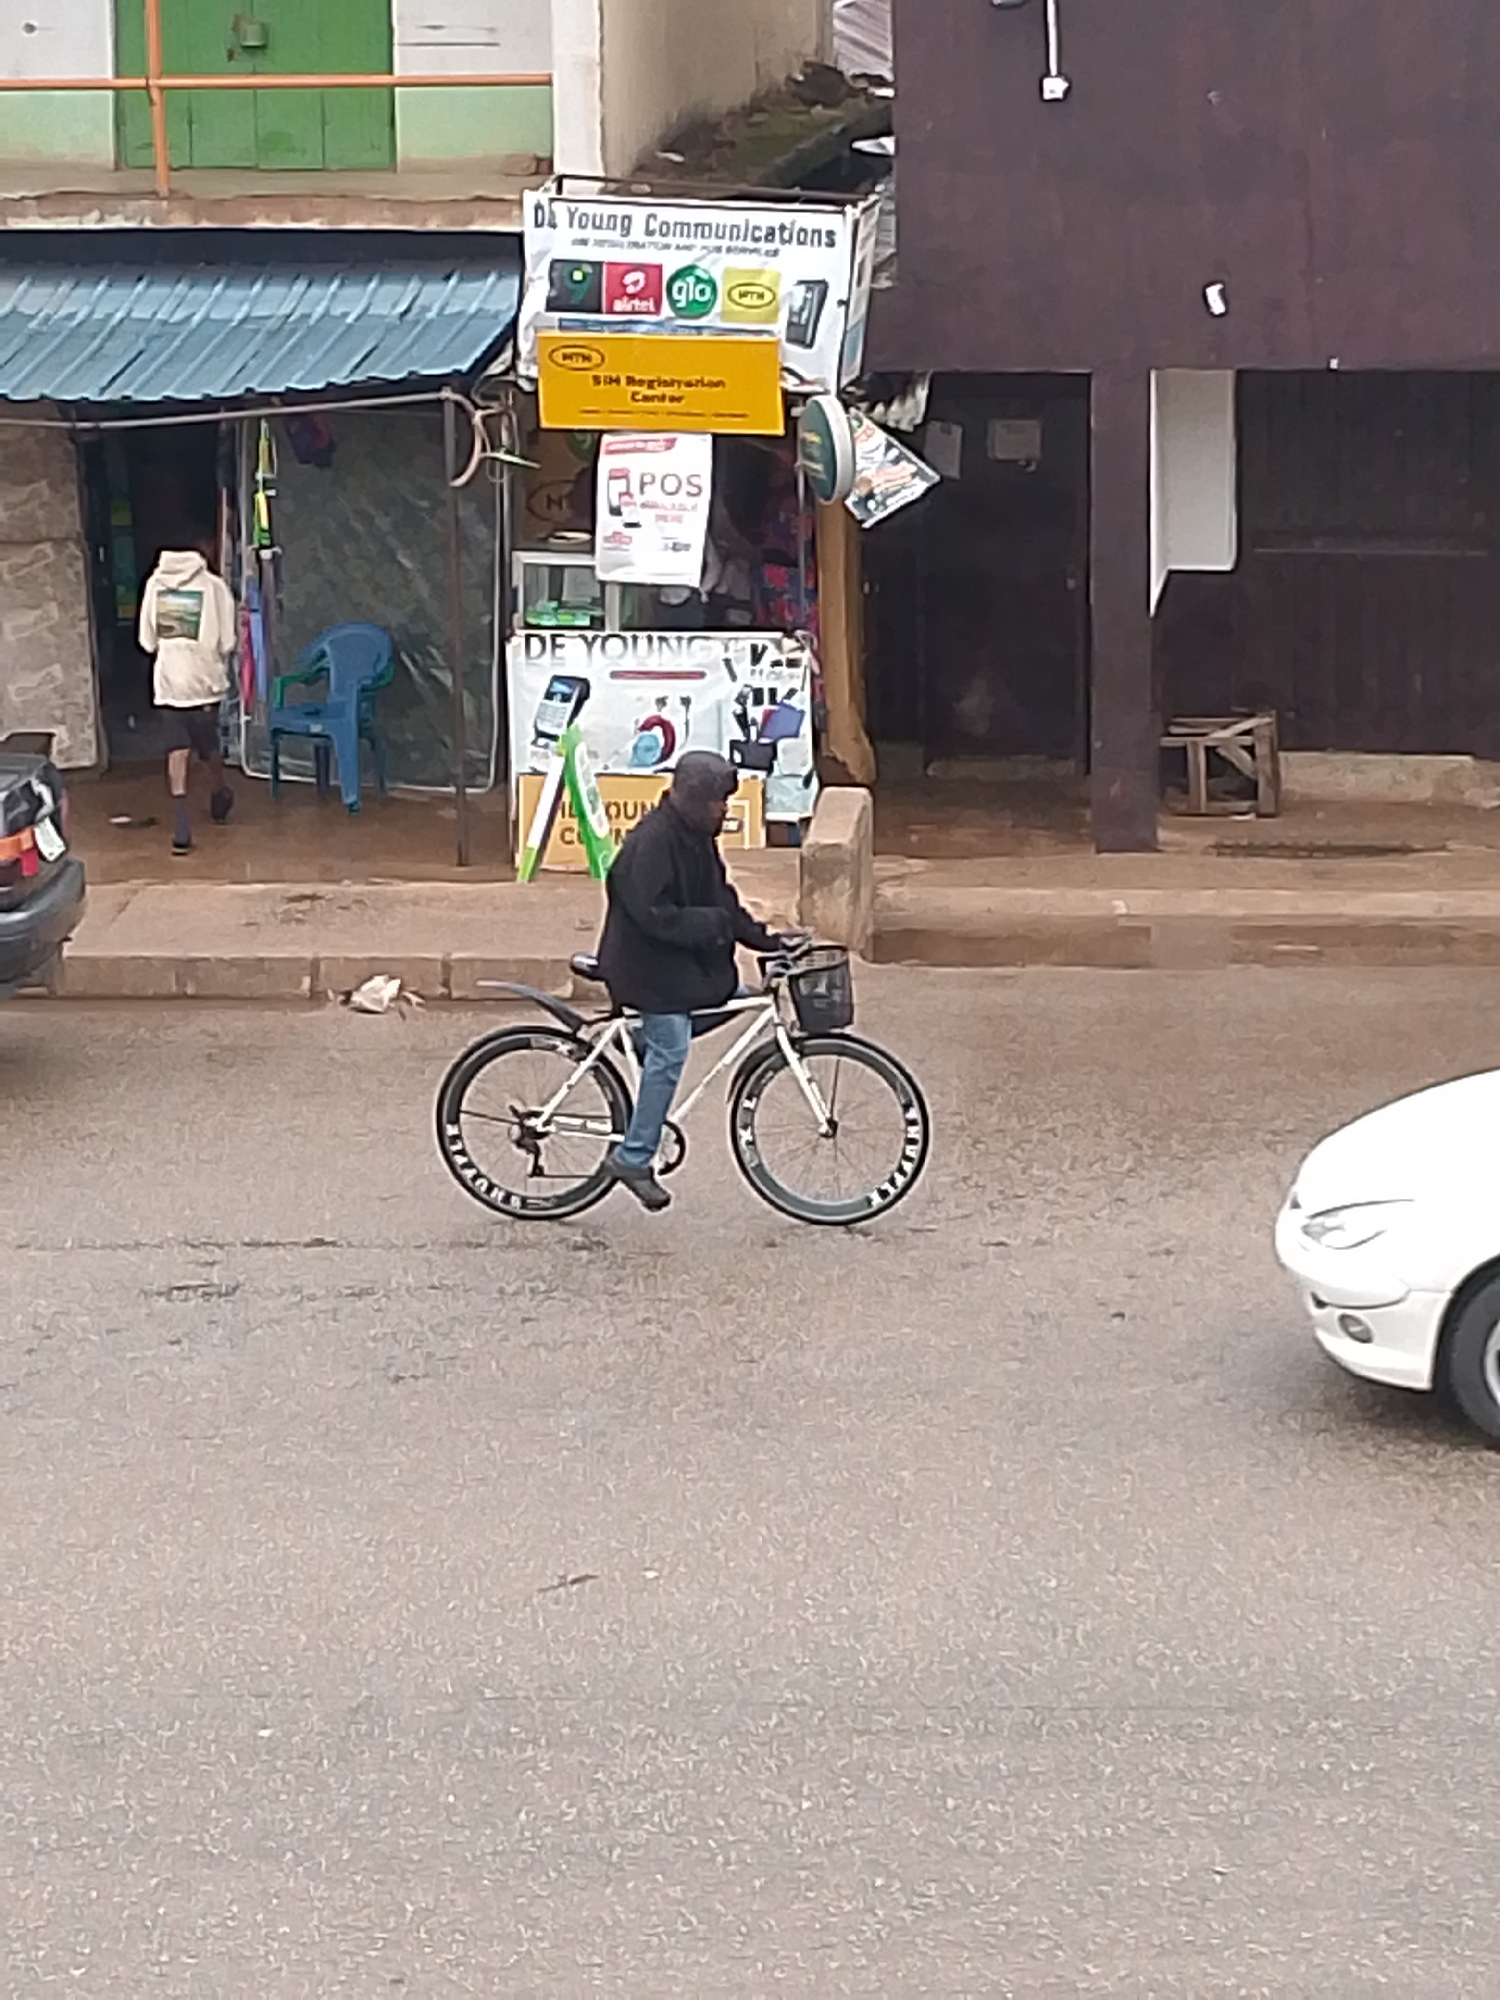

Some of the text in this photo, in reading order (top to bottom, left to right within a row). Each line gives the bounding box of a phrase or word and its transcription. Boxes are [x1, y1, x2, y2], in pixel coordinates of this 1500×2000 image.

[567, 206, 632, 237] Young
[644, 213, 836, 248] Communications
[613, 297, 655, 312] airtel
[672, 276, 711, 308] glo
[561, 352, 592, 363] MTN
[592, 374, 621, 386] SIM
[639, 472, 703, 497] POS
[525, 633, 566, 662] DE
